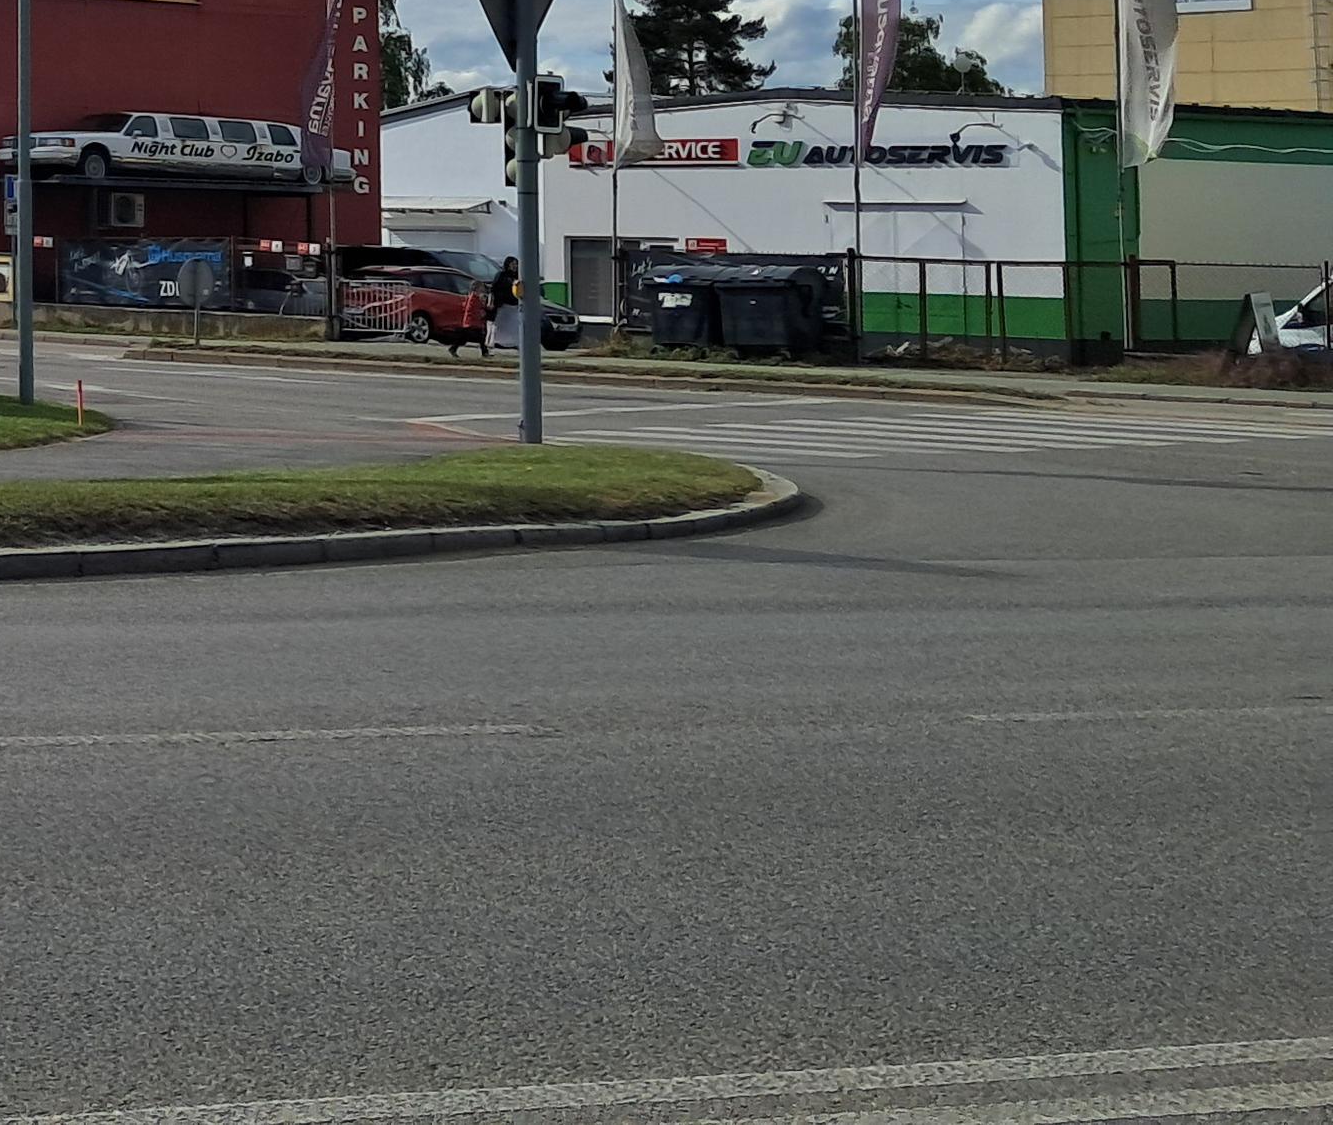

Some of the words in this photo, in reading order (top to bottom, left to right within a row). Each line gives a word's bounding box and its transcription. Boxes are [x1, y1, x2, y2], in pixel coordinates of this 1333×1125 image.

[352, 7, 371, 194] PARKING
[131, 140, 177, 157] Night
[180, 144, 215, 158] Club
[242, 145, 295, 163] Izabo
[654, 142, 721, 159] RVICE
